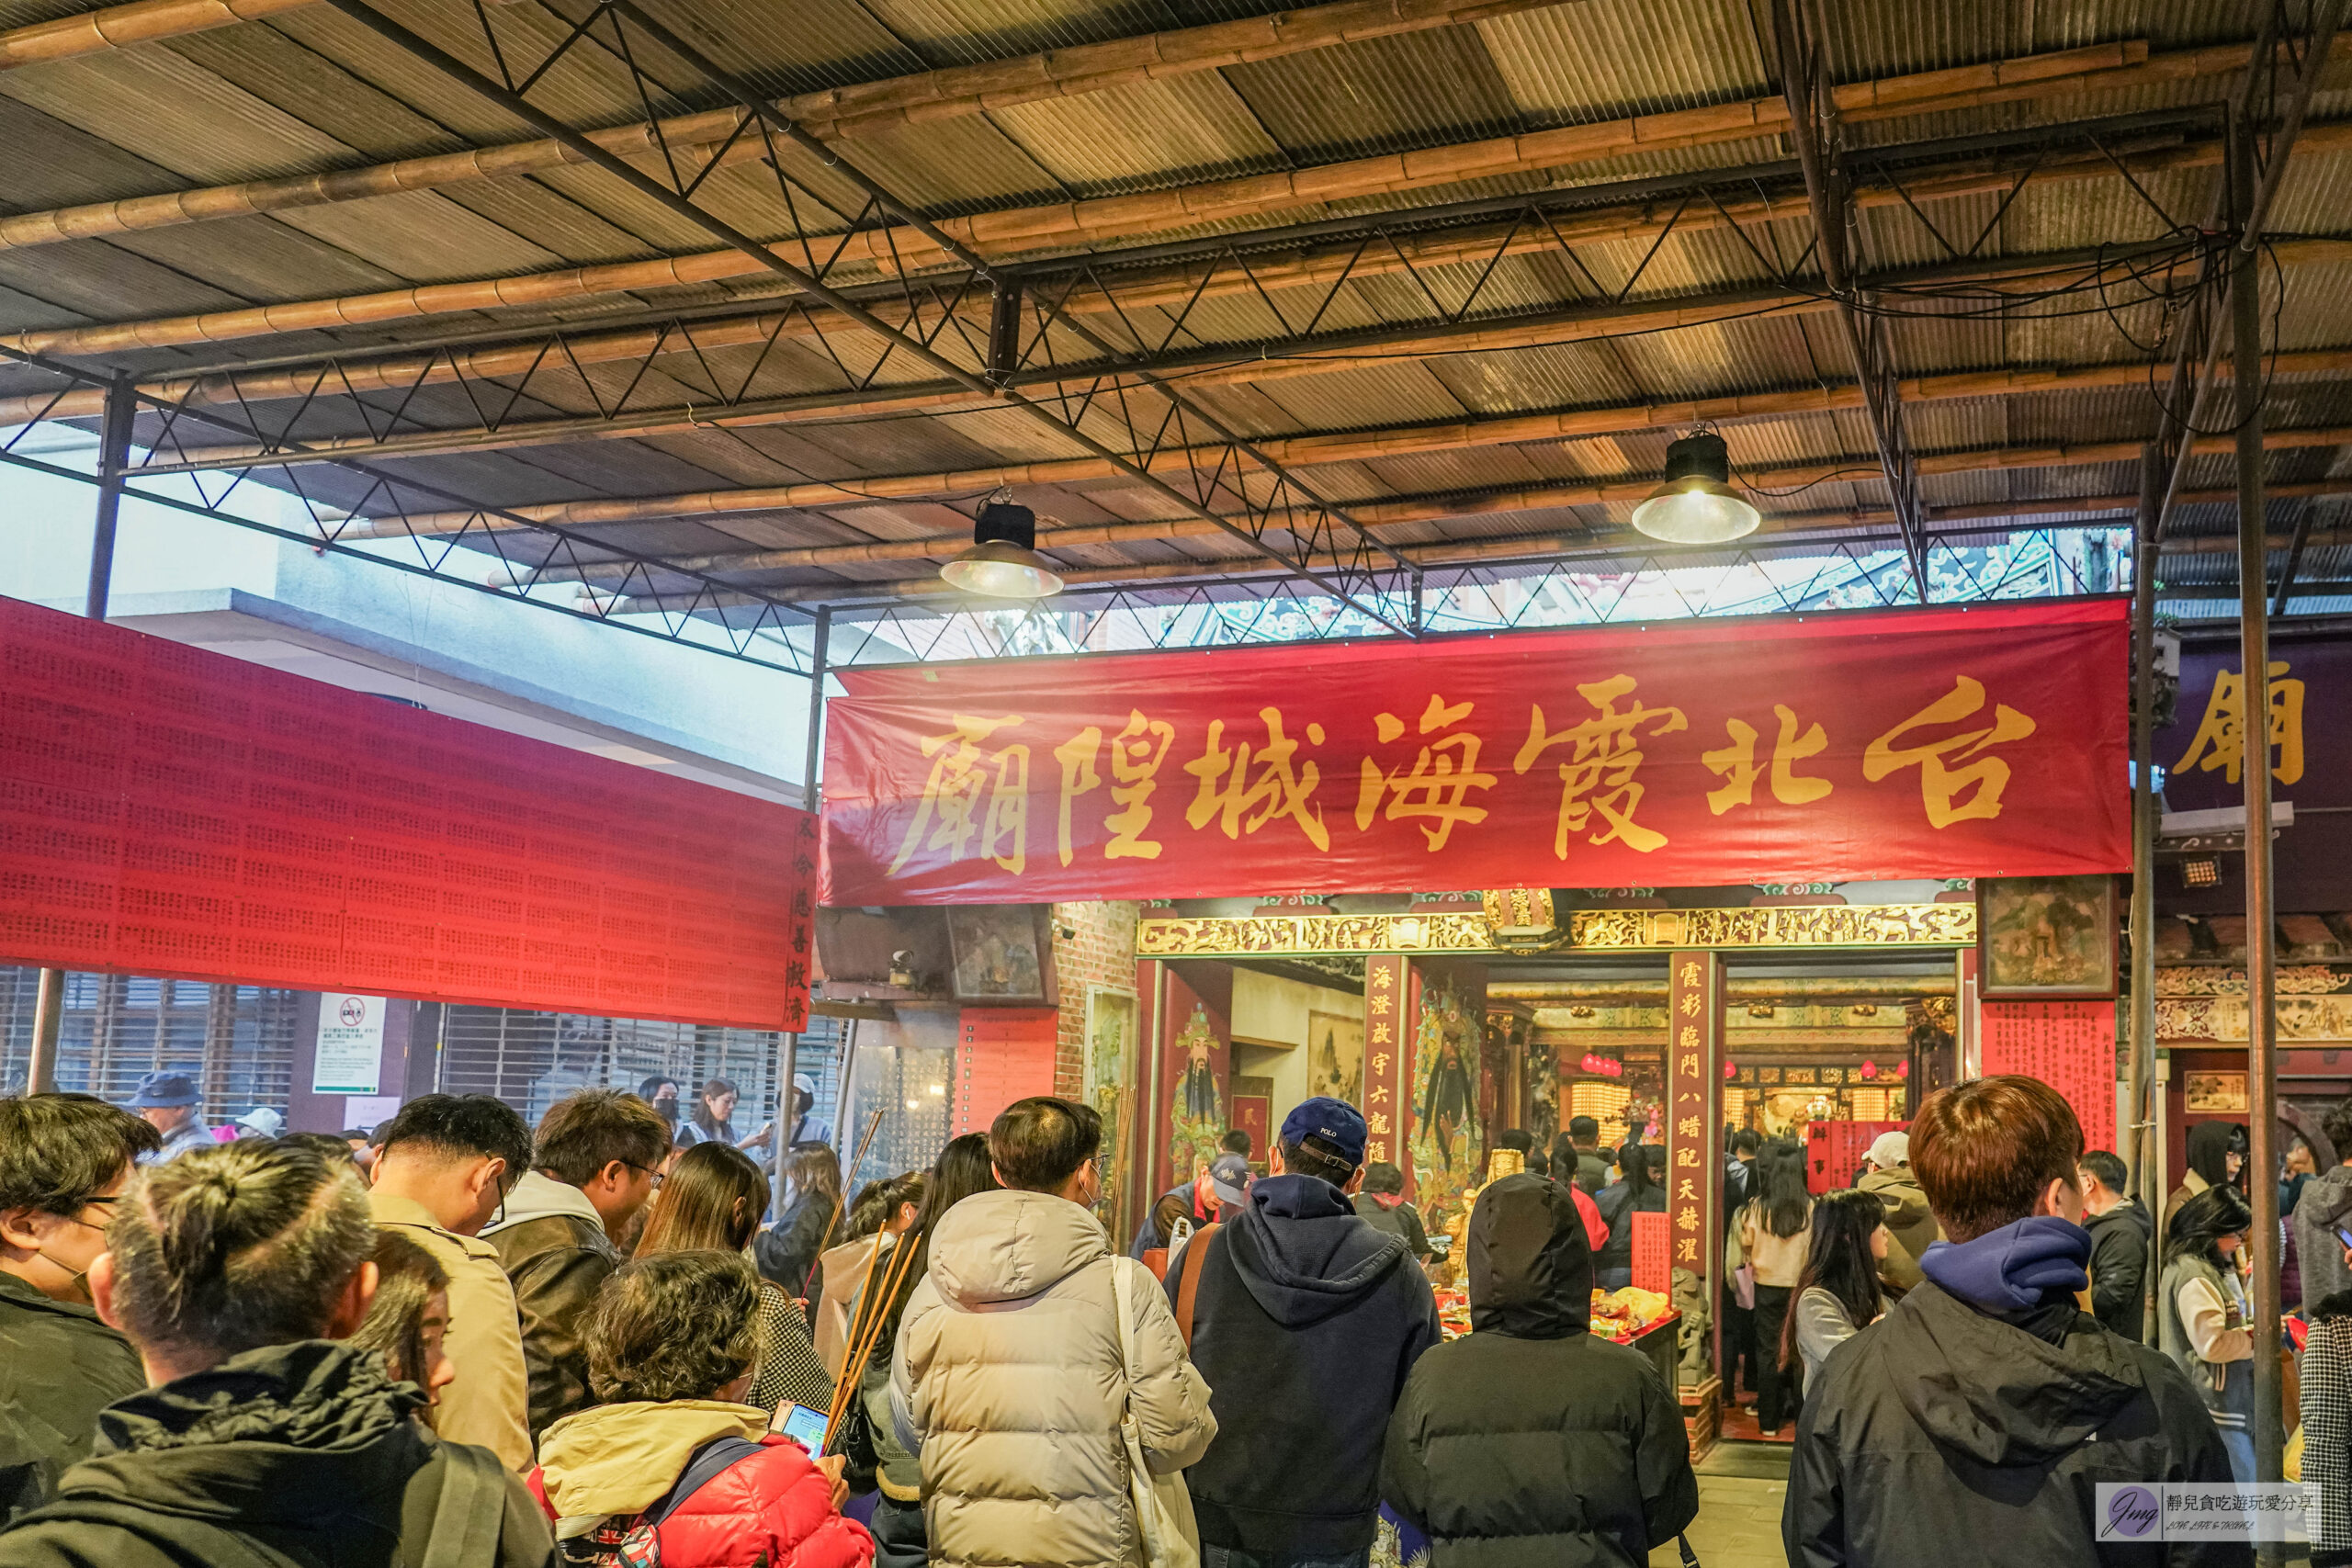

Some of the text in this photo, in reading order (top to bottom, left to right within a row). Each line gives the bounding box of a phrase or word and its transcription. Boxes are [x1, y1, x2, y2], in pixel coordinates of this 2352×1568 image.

[888, 674, 2037, 877] 台北霞海城隍廟
[2172, 660, 2305, 785] 廟
[1320, 1127, 1337, 1138] POLO
